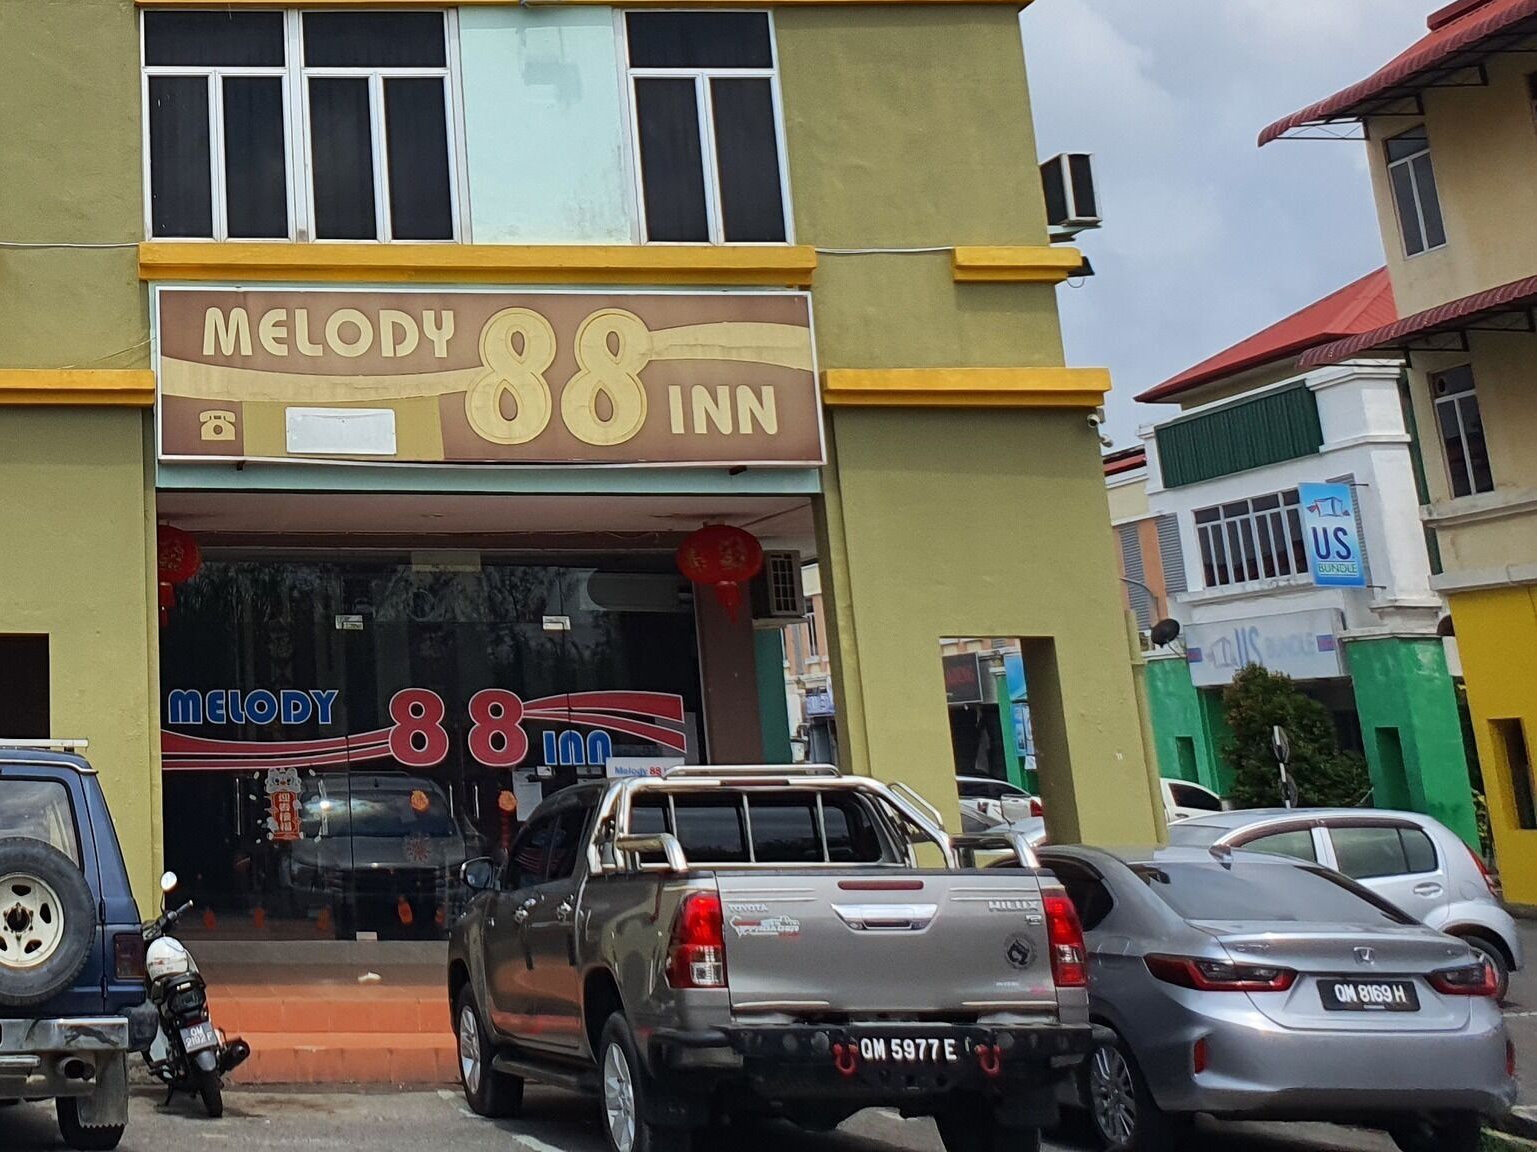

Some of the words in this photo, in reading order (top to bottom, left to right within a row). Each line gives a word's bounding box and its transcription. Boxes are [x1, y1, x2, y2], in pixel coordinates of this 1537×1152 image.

[202, 307, 454, 358] MELODY
[464, 307, 653, 446] 88
[668, 385, 777, 435] INN
[1318, 563, 1358, 573] BUNDLE
[168, 689, 339, 725] MELODY
[614, 766, 647, 777] Melody
[649, 767, 662, 775] 88
[728, 903, 769, 912] TOYOTA
[988, 900, 1038, 911] HILUX
[1335, 983, 1356, 1002] QM
[1358, 983, 1392, 1002] 8169
[1394, 983, 1407, 1002] H
[861, 1037, 885, 1061] QM
[891, 1038, 939, 1061] 5977
[944, 1038, 957, 1060] E
